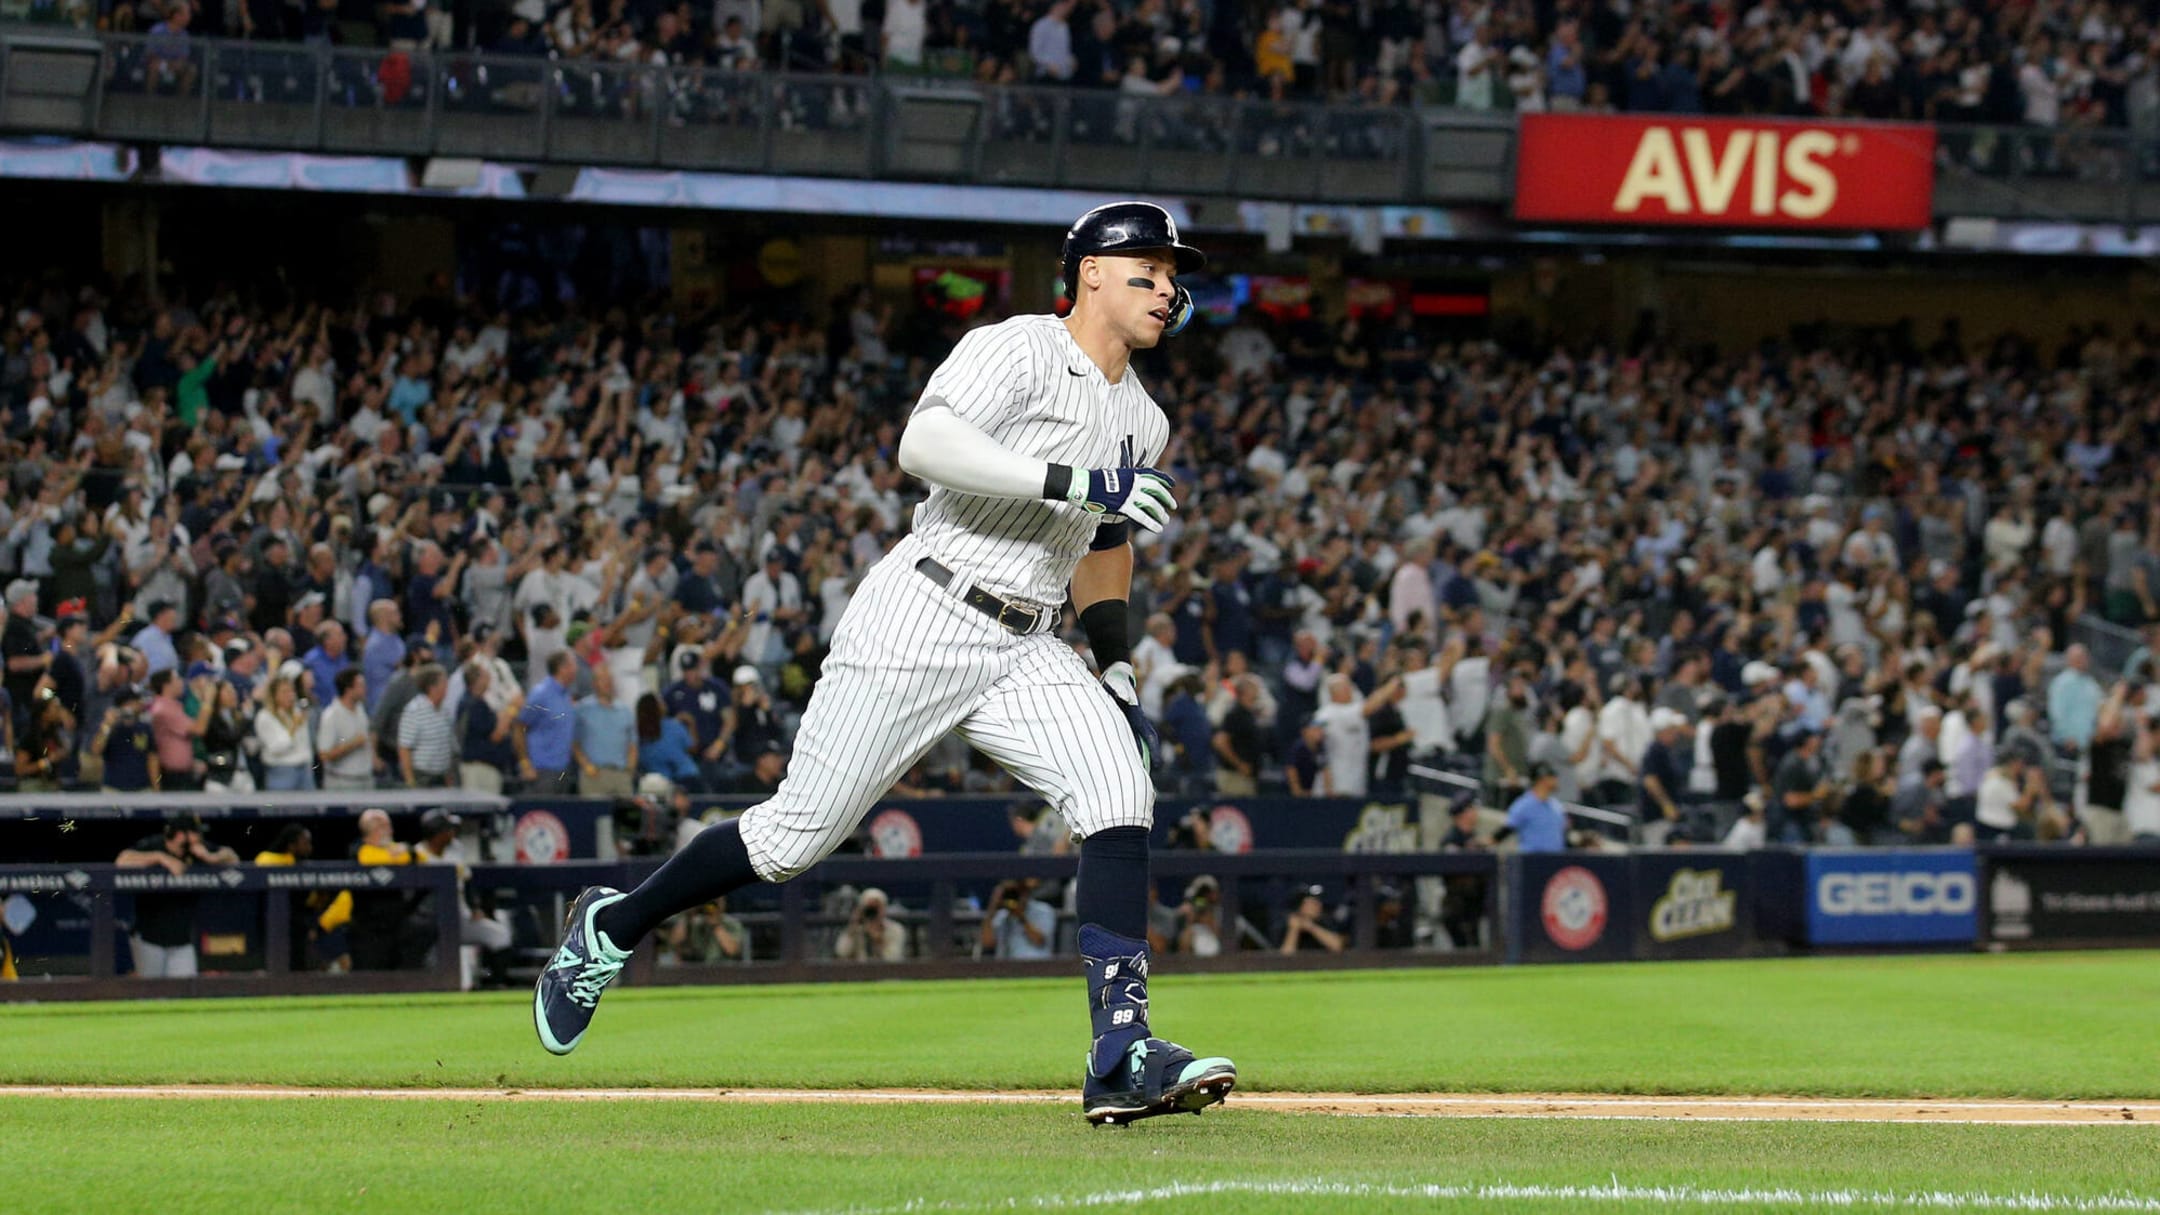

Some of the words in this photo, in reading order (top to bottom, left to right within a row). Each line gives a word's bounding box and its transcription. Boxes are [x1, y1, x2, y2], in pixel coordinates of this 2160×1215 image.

[1613, 126, 1838, 218] AVIS
[1817, 872, 1976, 916] GEICO
[1112, 1009, 1134, 1025] 99
